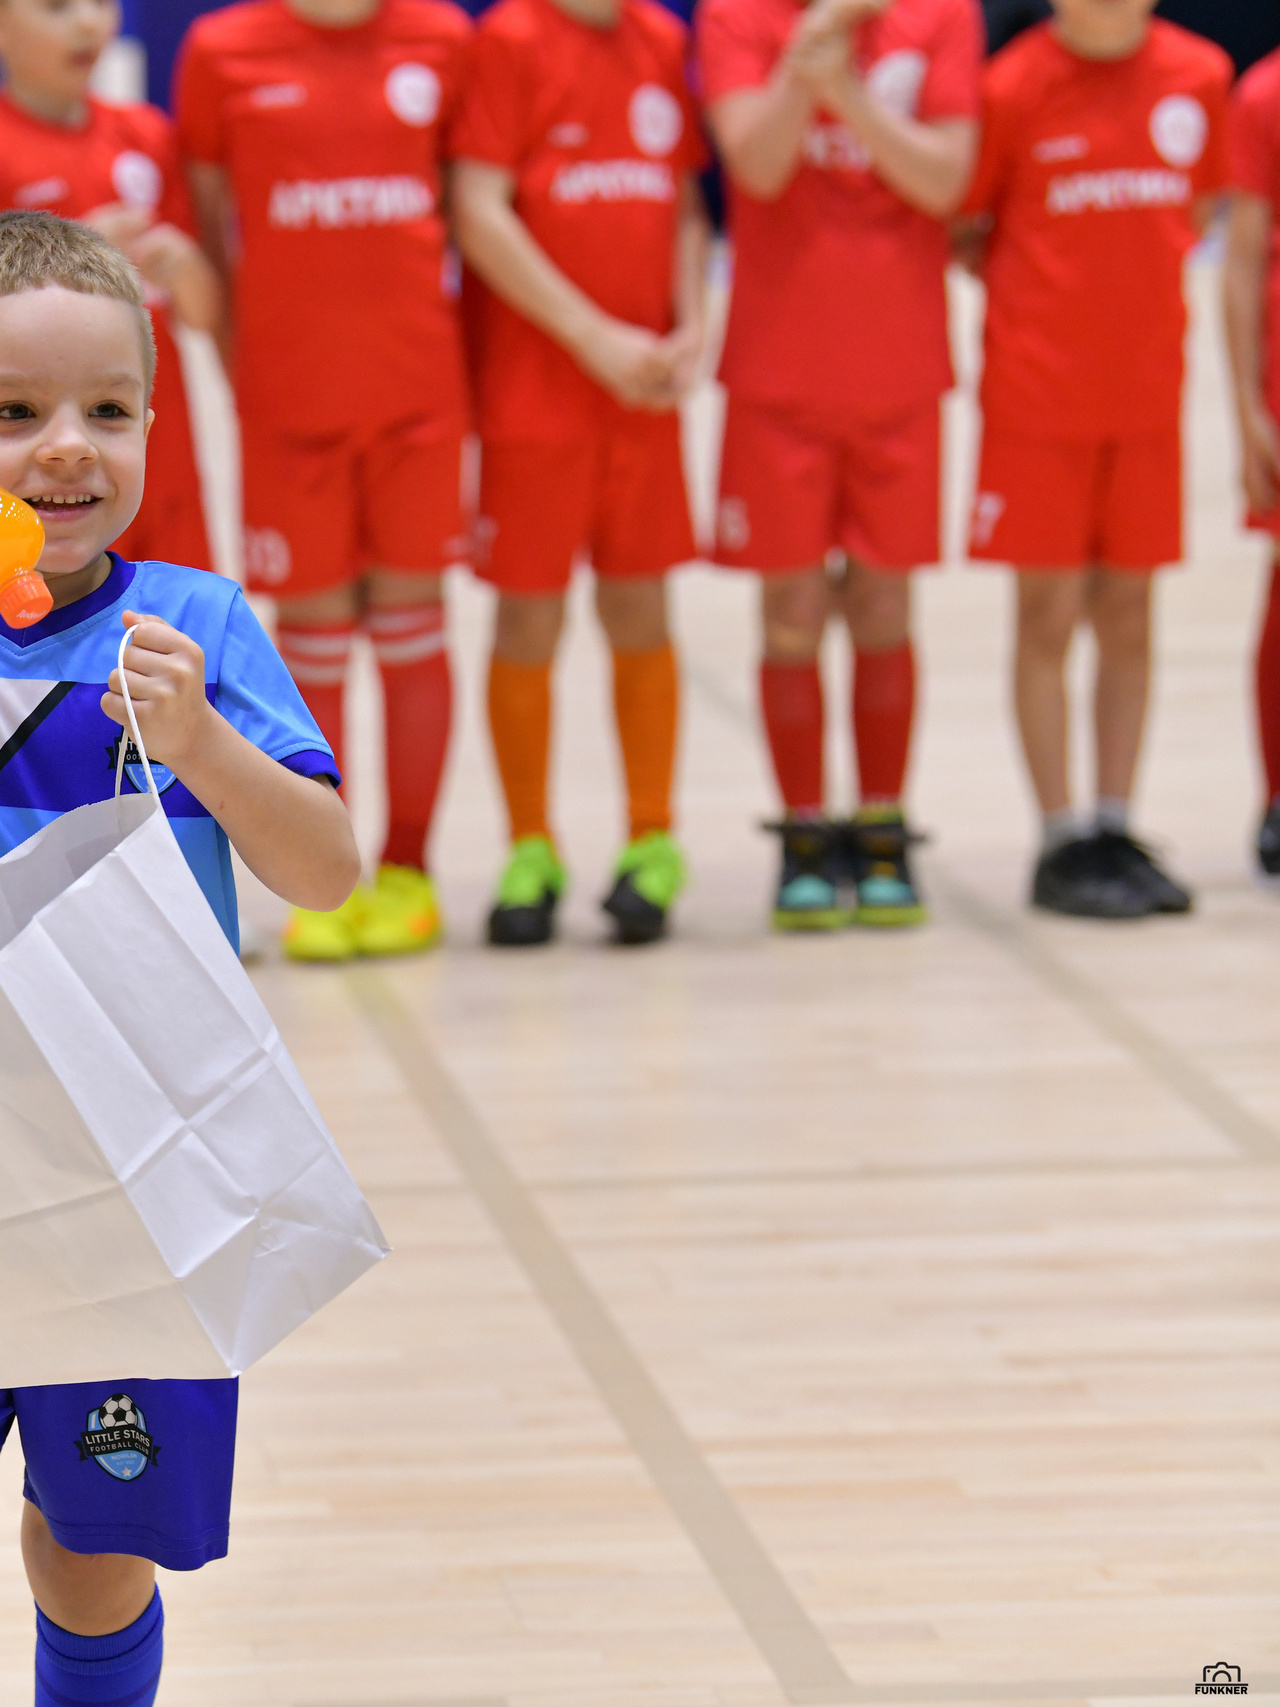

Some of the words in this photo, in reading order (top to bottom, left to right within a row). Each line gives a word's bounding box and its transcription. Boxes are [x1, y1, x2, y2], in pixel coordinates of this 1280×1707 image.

[85, 1431, 120, 1445] LITTLE
[123, 1429, 150, 1447] STARS
[90, 1441, 132, 1452] FOOTBALL
[134, 1442, 149, 1455] CLUB
